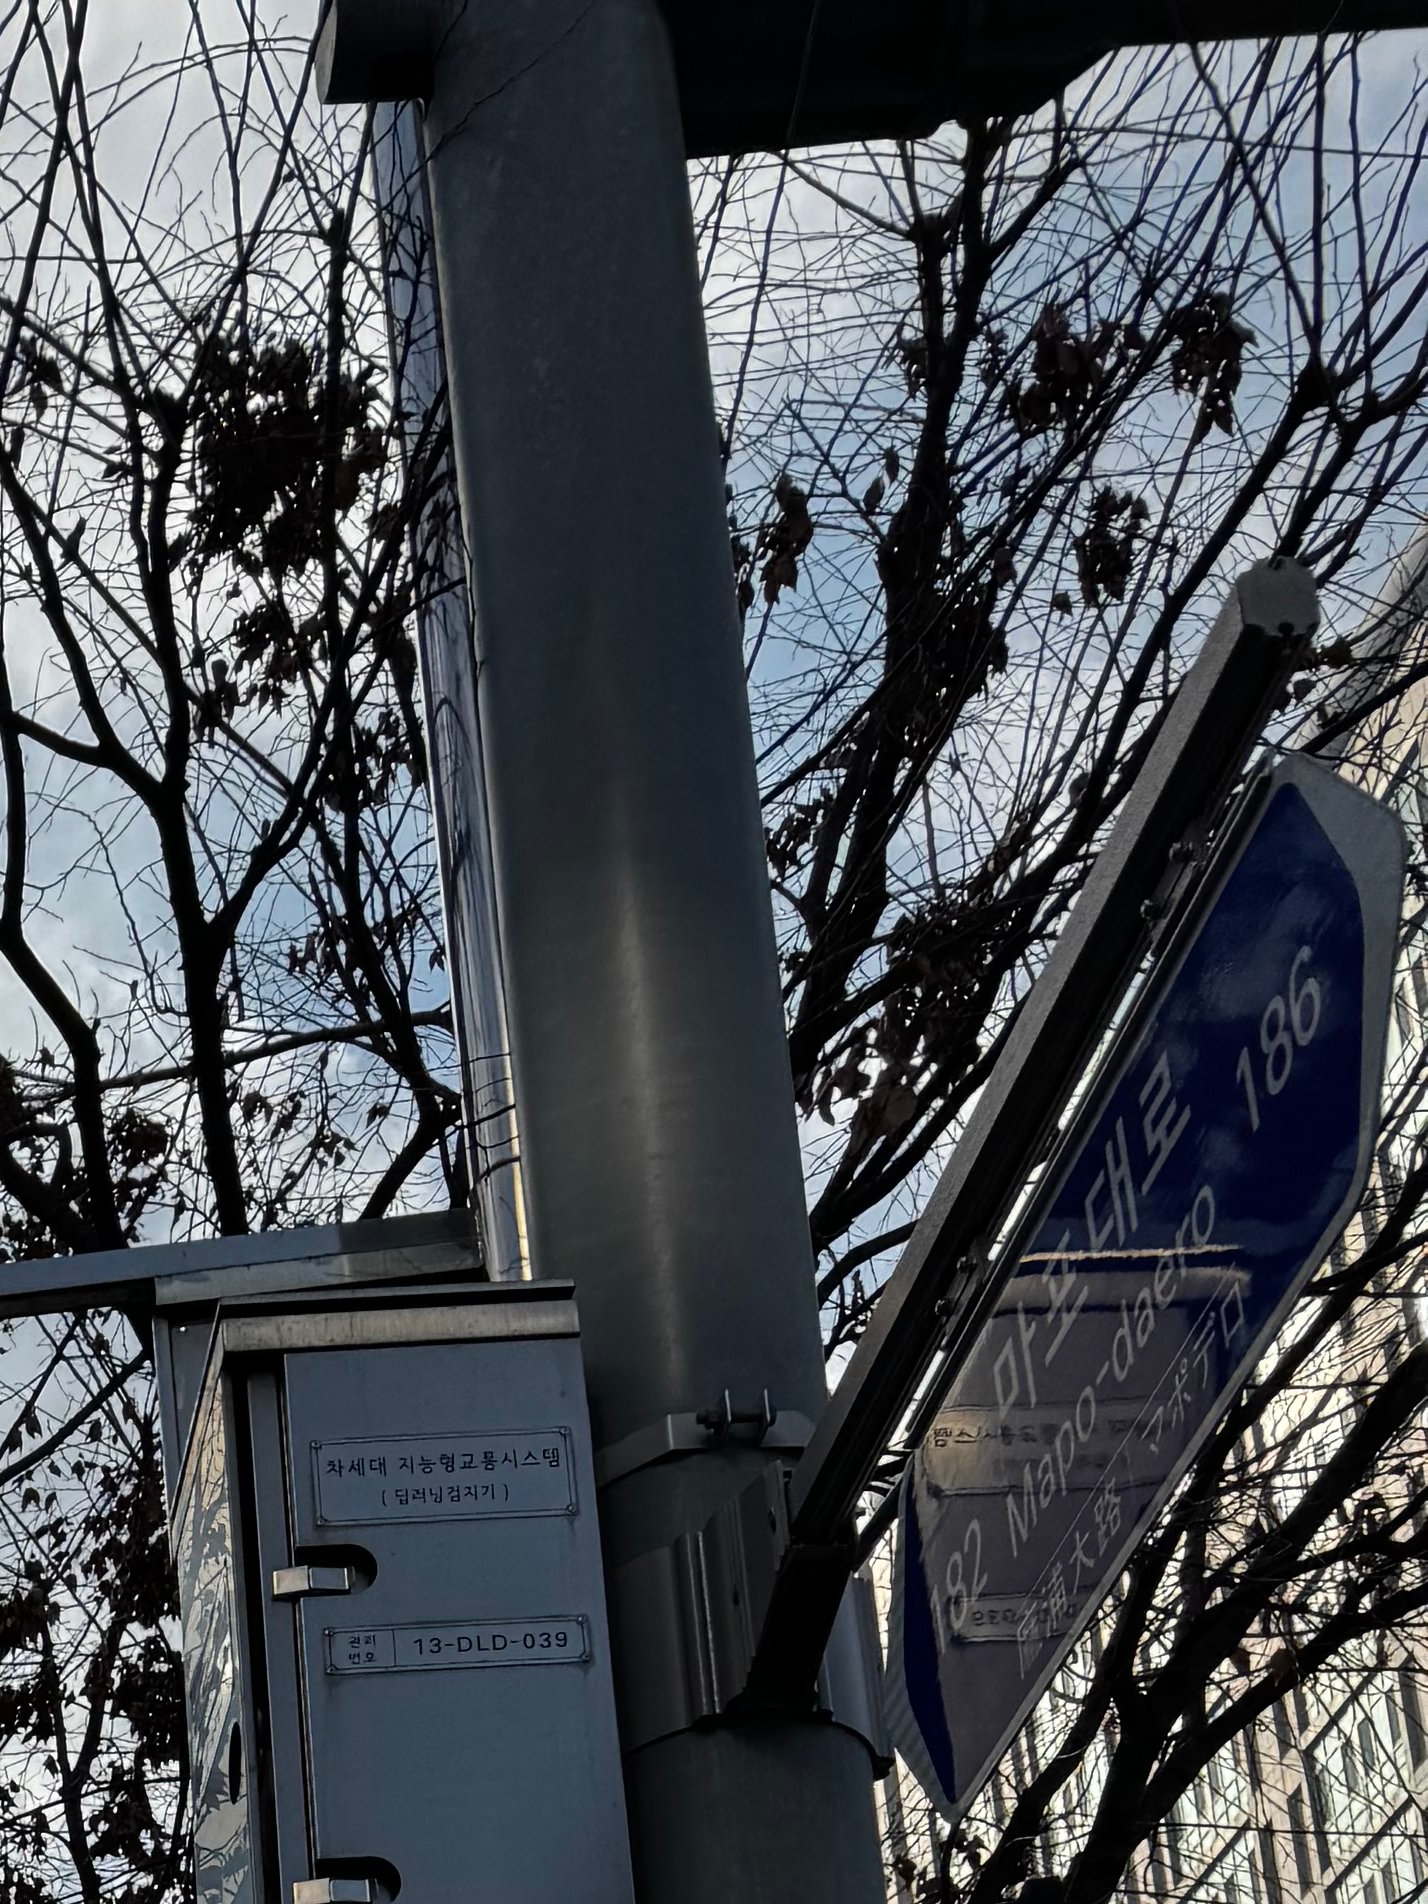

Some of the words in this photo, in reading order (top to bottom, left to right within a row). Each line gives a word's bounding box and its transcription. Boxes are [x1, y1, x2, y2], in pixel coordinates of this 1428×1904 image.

[1235, 945, 1321, 1131] 186
[992, 1049, 1190, 1411] 마포대로
[326, 1457, 387, 1477] 차세대
[400, 1448, 561, 1474] 지능형교통시스템
[1007, 1184, 1215, 1557] Mapo-daero
[414, 1631, 568, 1656] 13-DLD-039
